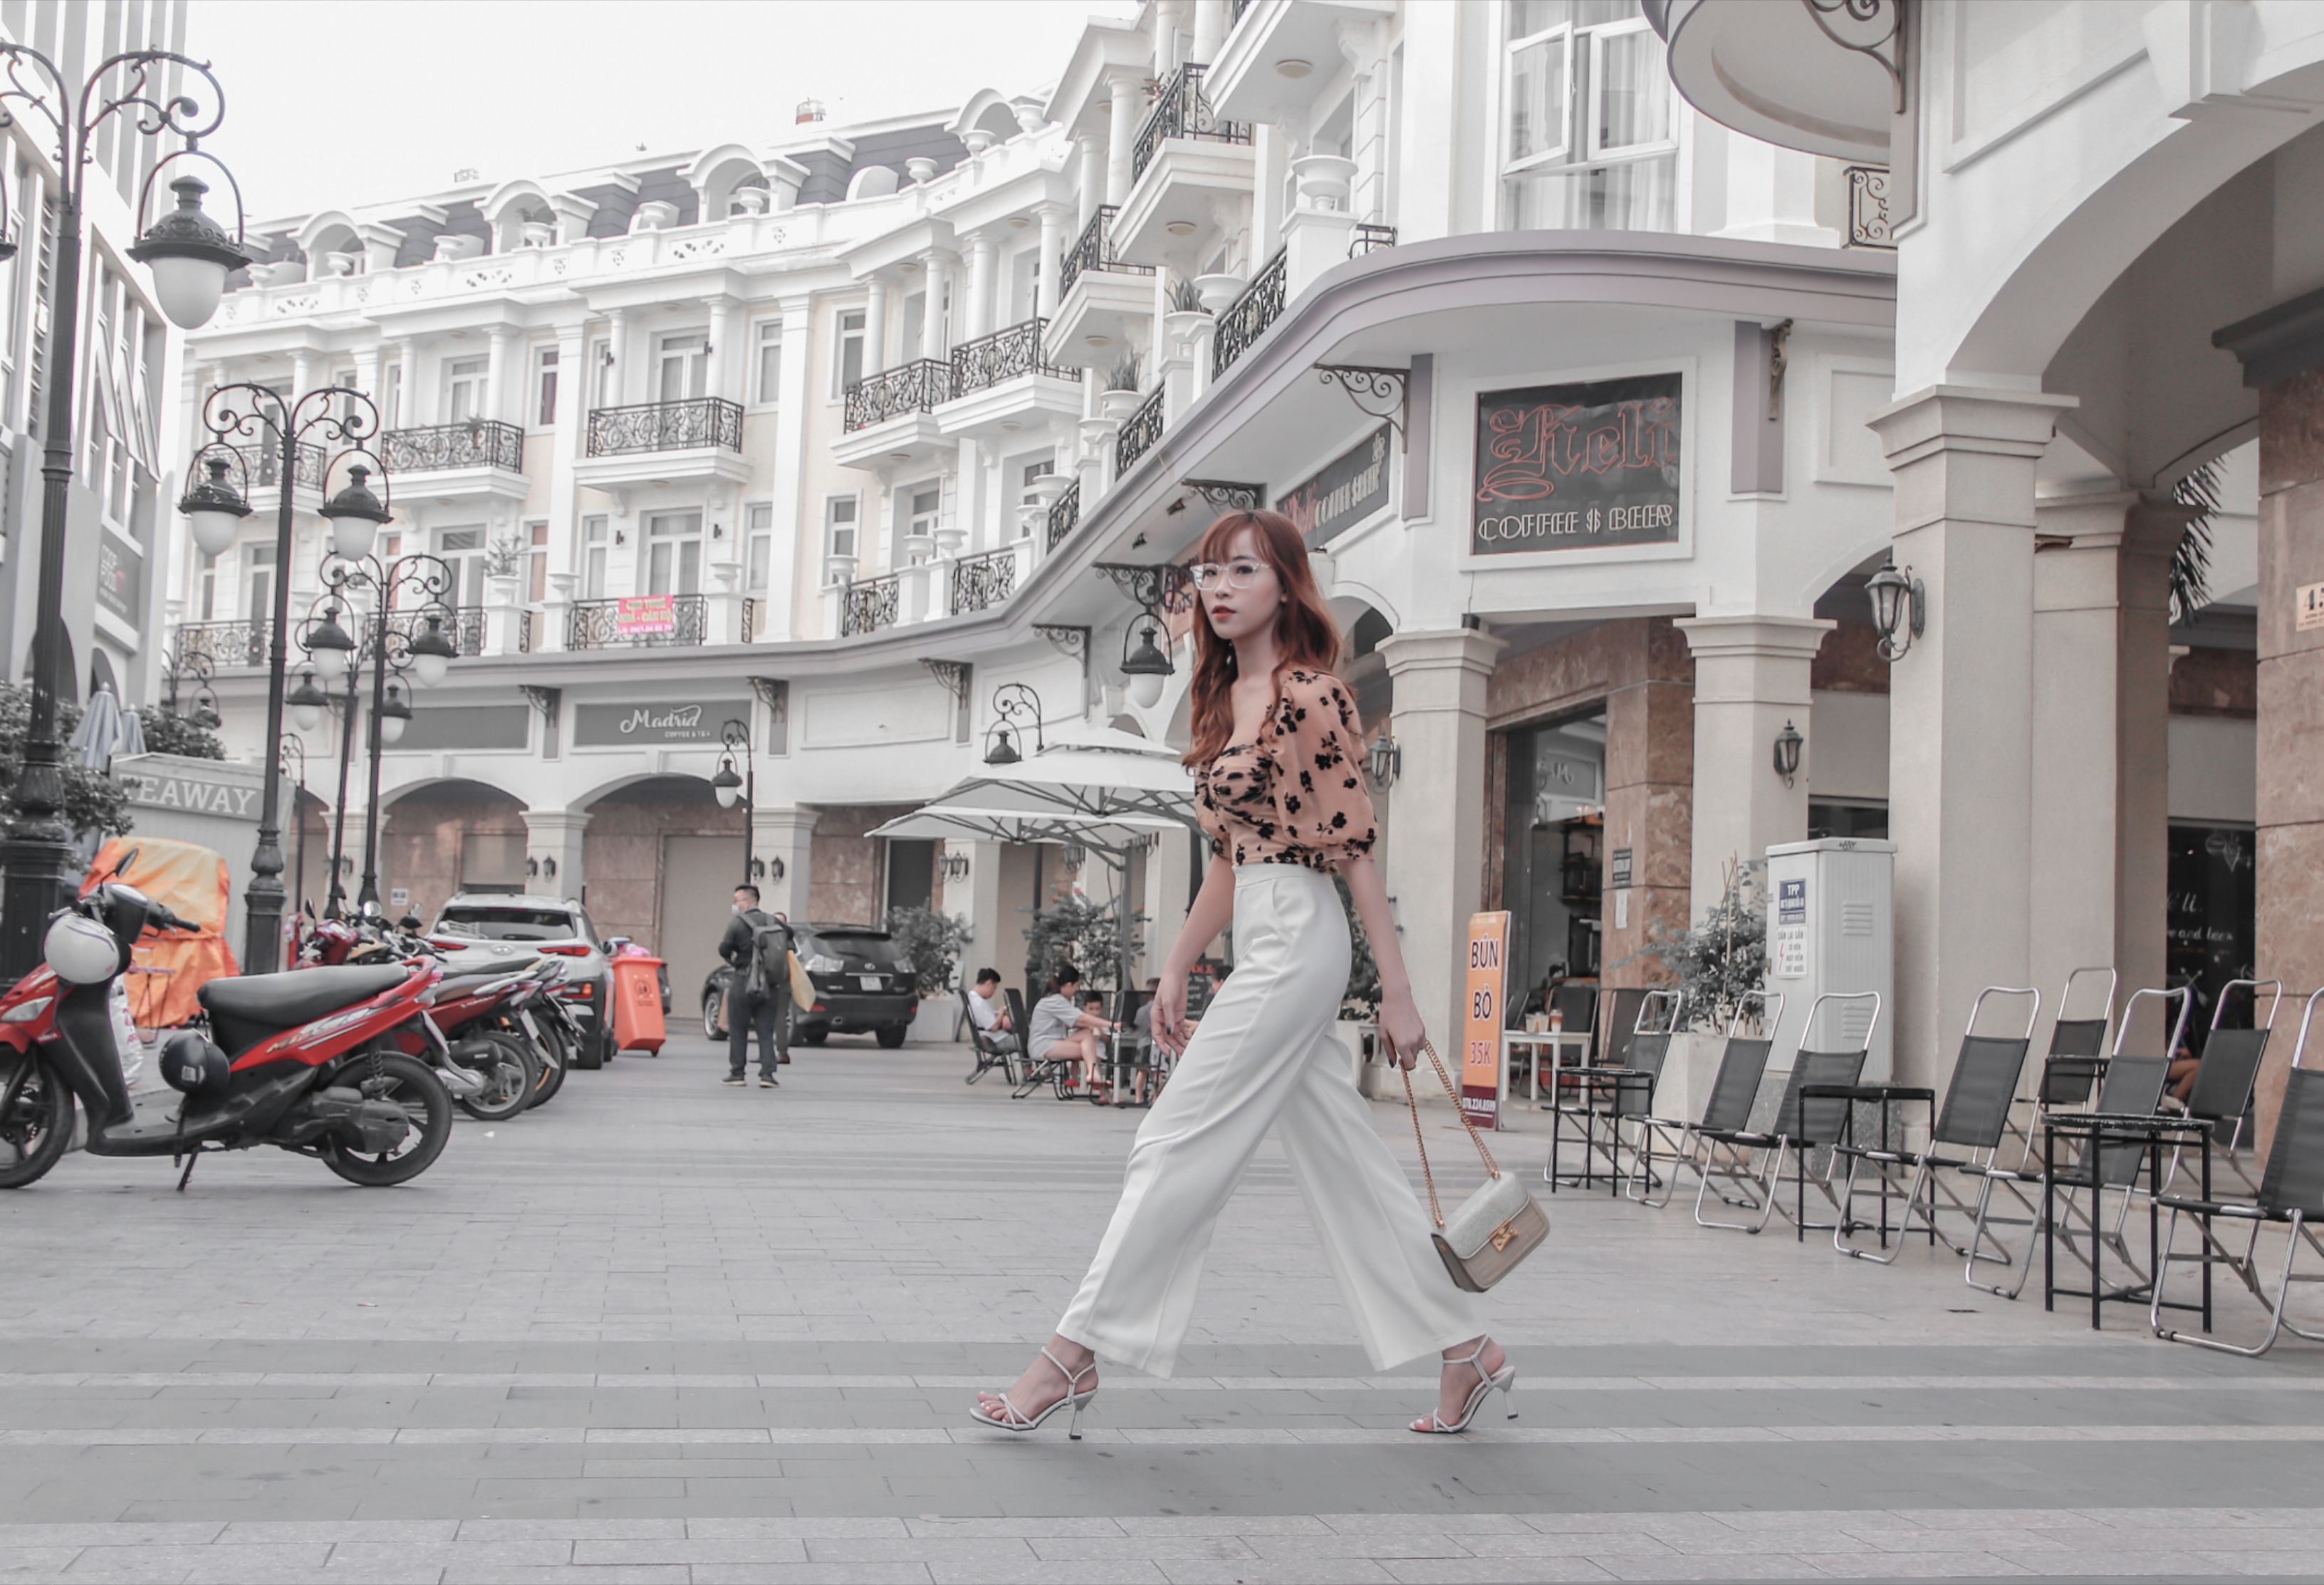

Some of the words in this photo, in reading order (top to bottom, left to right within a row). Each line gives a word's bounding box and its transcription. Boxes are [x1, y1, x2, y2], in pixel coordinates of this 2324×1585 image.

[1478, 511, 1579, 541] COFFEE
[1608, 504, 1673, 531] BEER
[2303, 588, 2324, 610] 4
[620, 704, 702, 734] Madrid
[1471, 935, 1499, 969] BÚN
[1473, 987, 1492, 1019] BÒ
[1469, 1041, 1491, 1065] 35K
